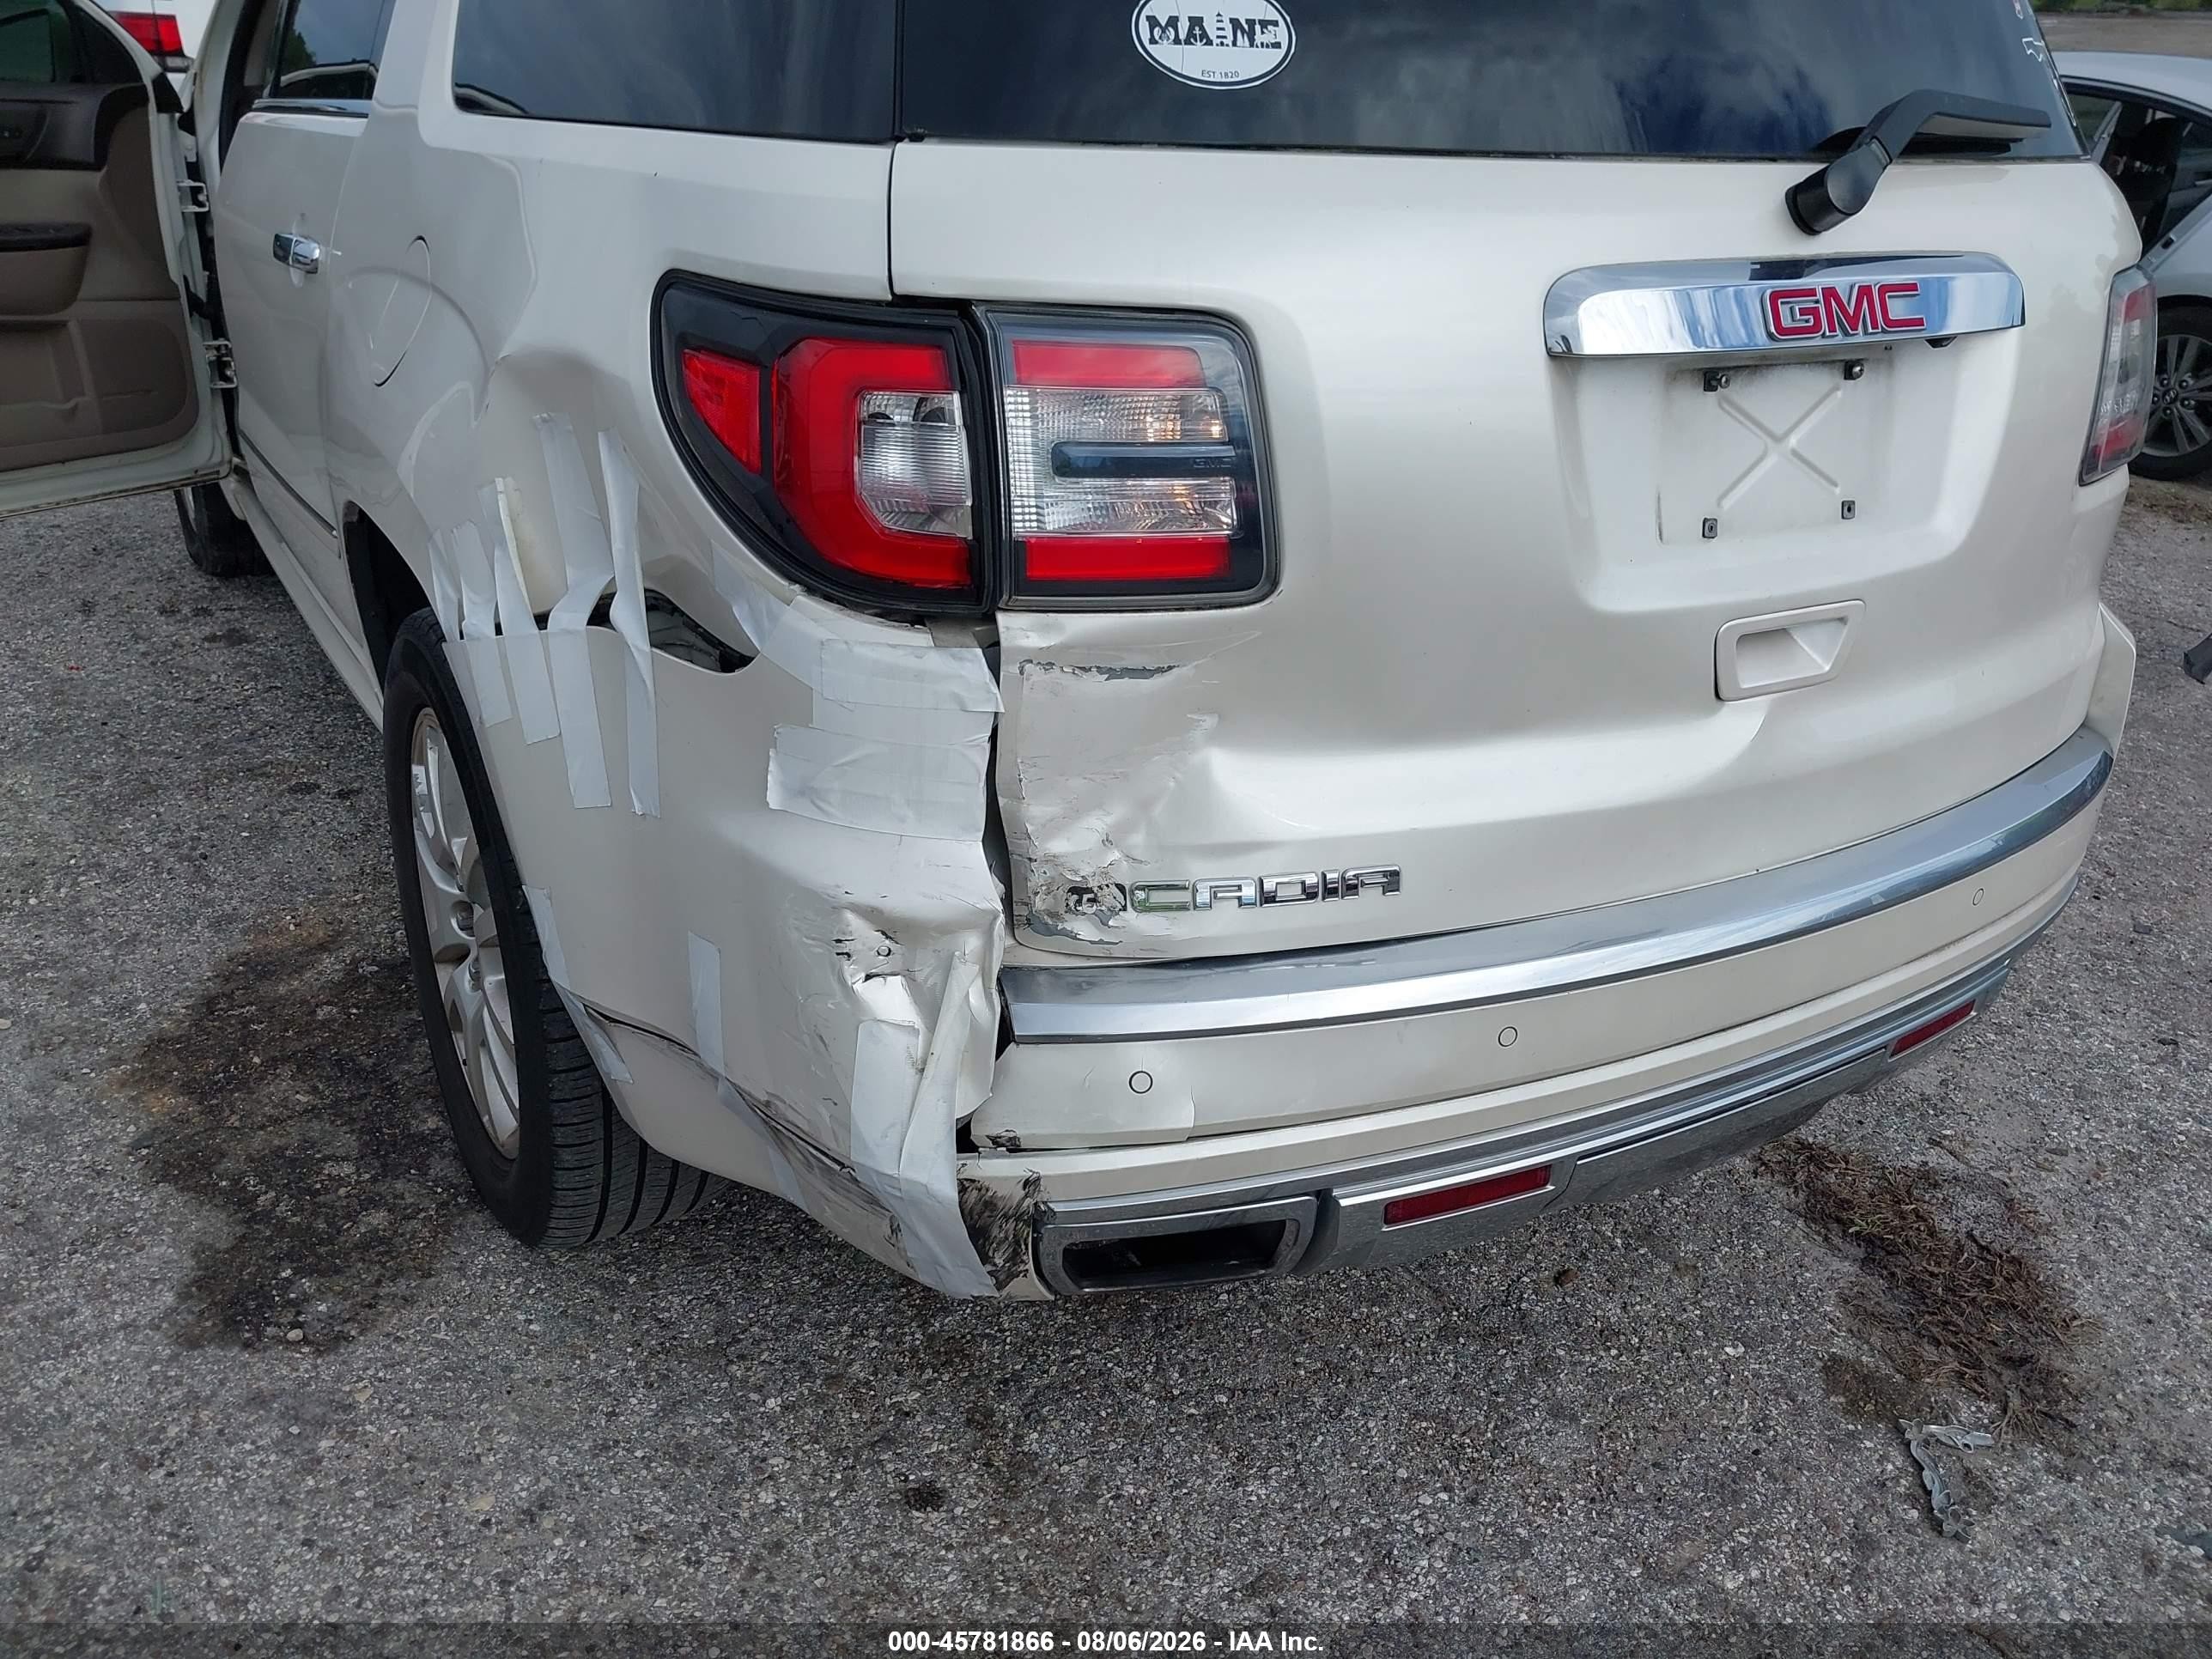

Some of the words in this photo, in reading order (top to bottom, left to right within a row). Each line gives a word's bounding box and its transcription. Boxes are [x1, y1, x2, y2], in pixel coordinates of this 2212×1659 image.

[1146, 13, 1282, 49] MAINE
[1219, 70, 1240, 79] 1820
[1764, 281, 1927, 341] GMC
